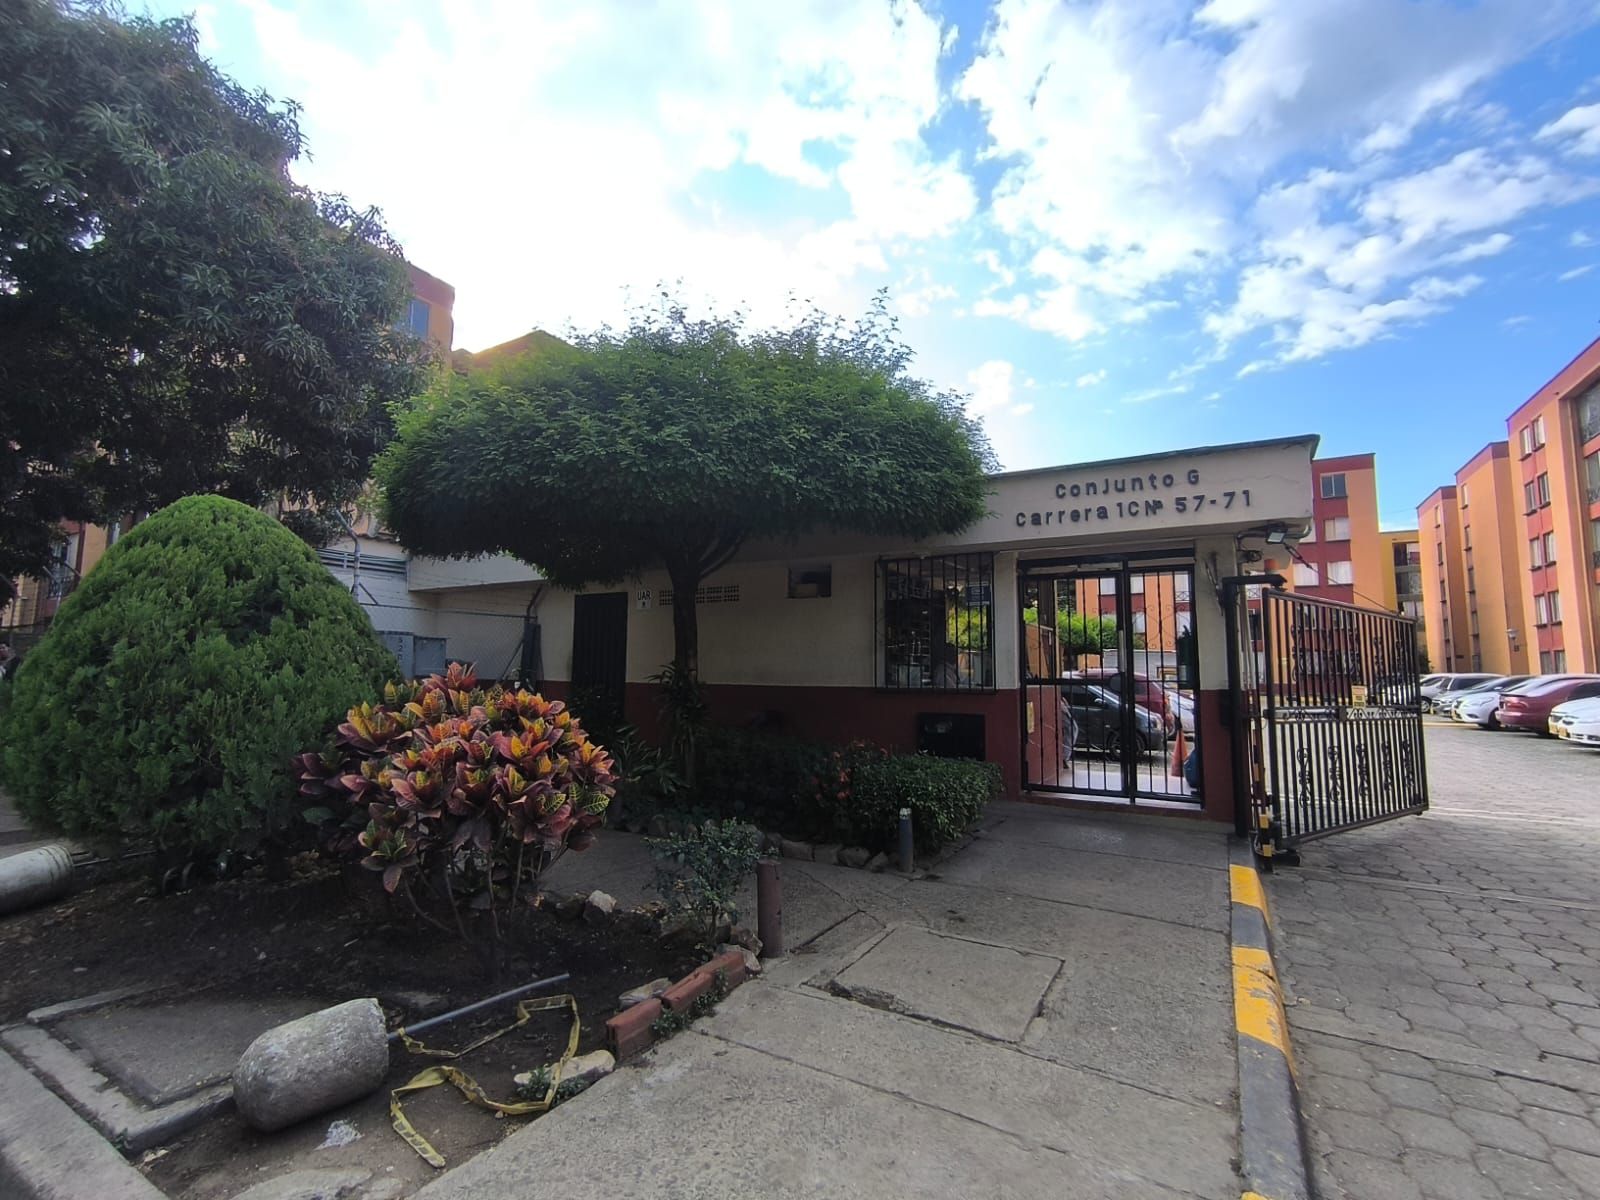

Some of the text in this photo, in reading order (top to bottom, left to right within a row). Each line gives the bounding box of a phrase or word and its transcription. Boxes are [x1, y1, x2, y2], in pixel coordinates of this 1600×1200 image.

[1056, 469, 1200, 499] Conjunto G
[1175, 489, 1250, 513] 57-71
